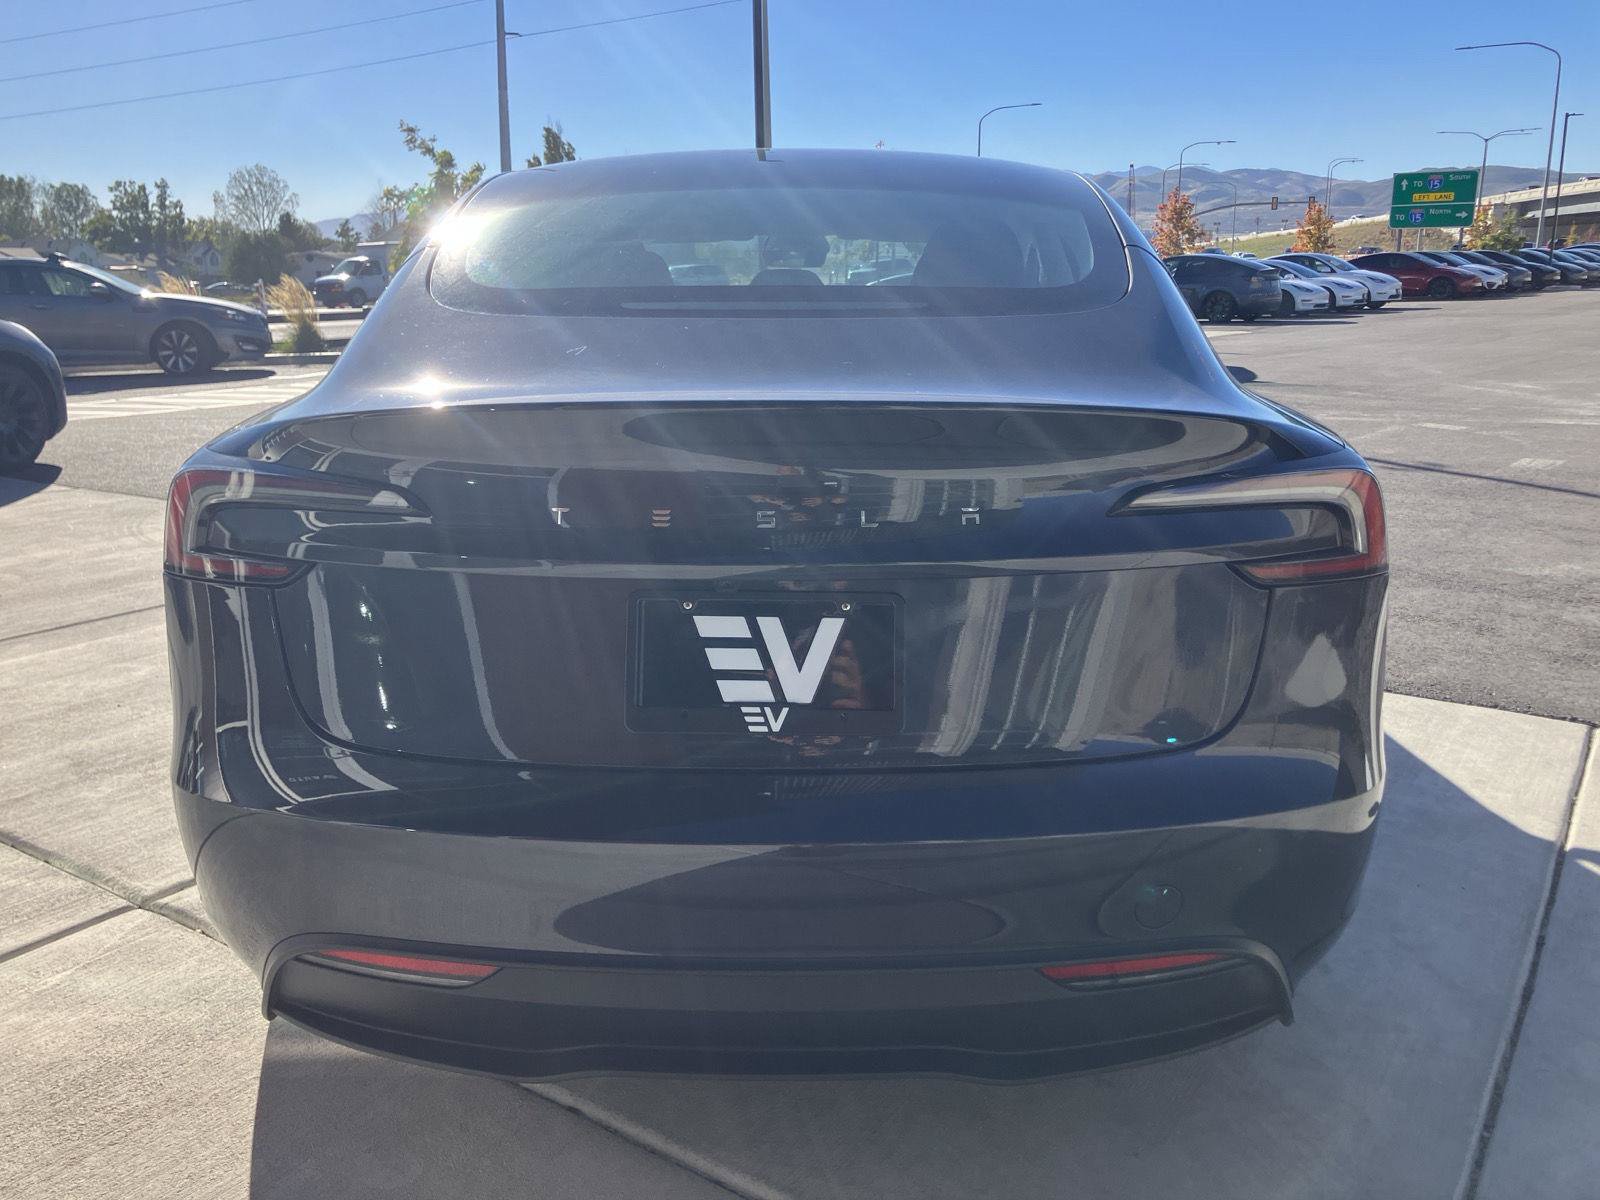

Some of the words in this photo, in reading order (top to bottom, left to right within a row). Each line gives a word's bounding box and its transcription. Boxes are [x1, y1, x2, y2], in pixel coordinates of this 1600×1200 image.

[1413, 180, 1423, 188] TO
[1430, 179, 1440, 189] 15
[1412, 213, 1422, 223] 15
[692, 615, 846, 704] EV
[740, 706, 790, 733] EV
